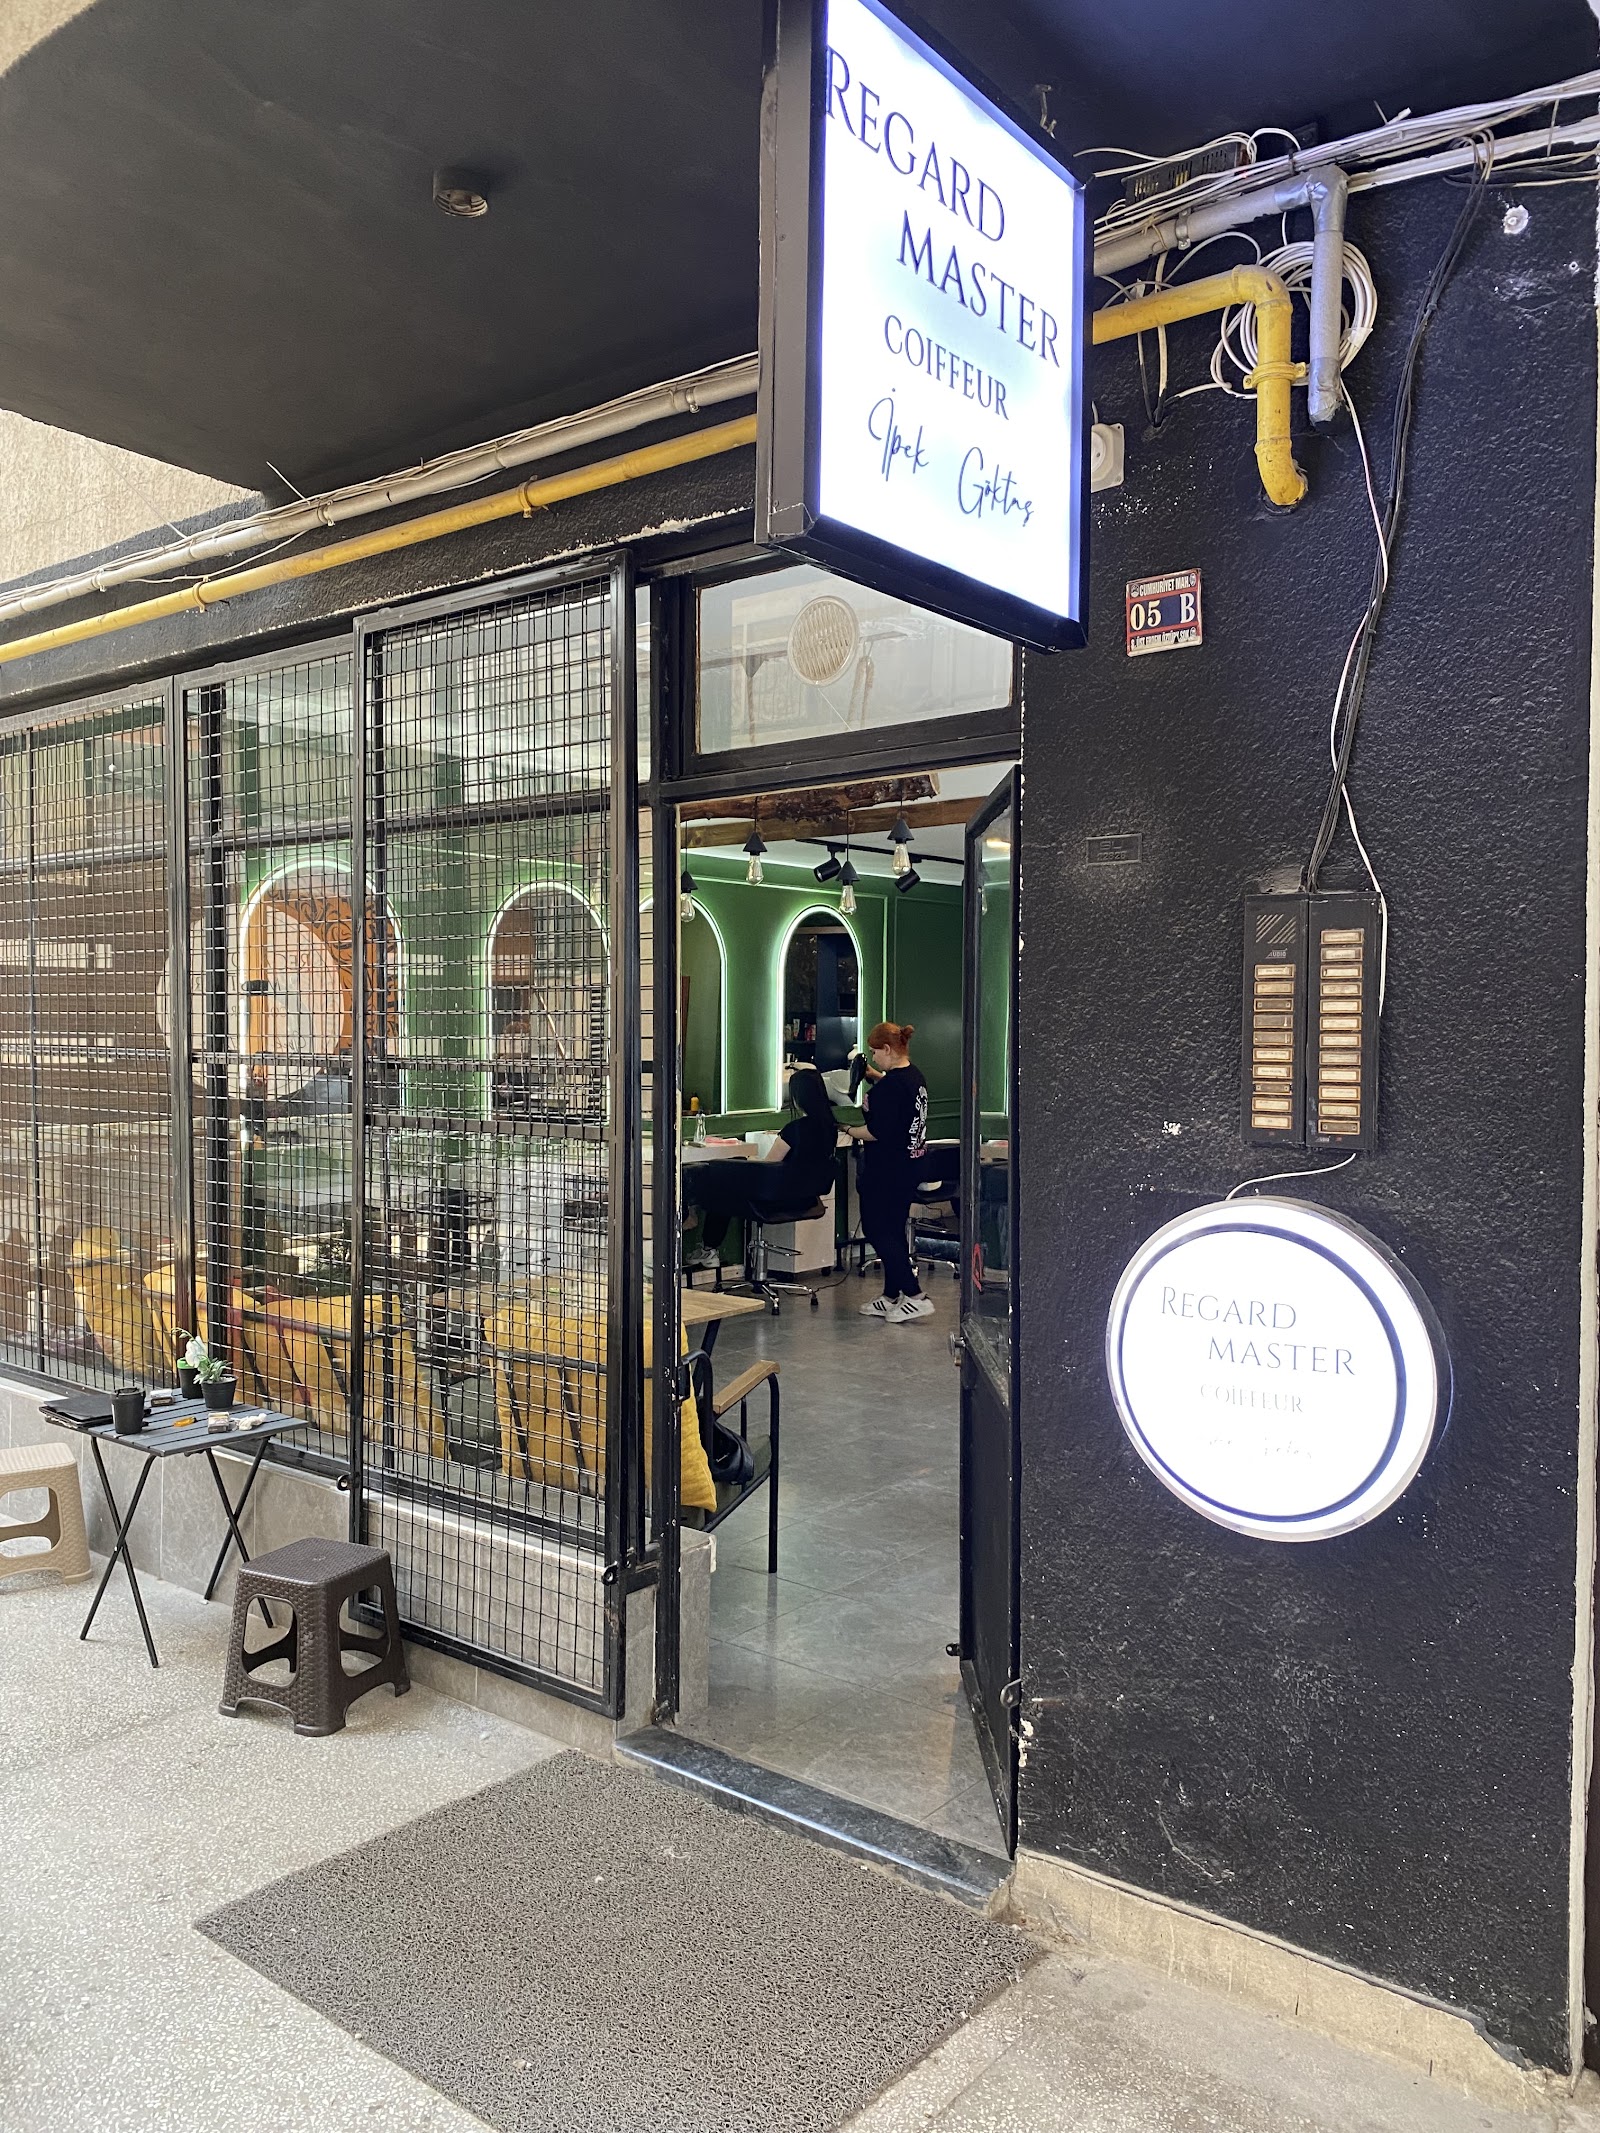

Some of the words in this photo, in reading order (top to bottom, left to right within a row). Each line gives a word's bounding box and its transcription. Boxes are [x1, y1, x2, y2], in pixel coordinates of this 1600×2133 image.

[825, 45, 1005, 242] REGARD
[897, 210, 1060, 368] MASTER
[884, 315, 1009, 420] COIFFEUR
[1130, 600, 1161, 631] 05
[1180, 592, 1195, 623] B
[1161, 1286, 1297, 1329] REGARD
[1208, 1336, 1355, 1375] MASTER
